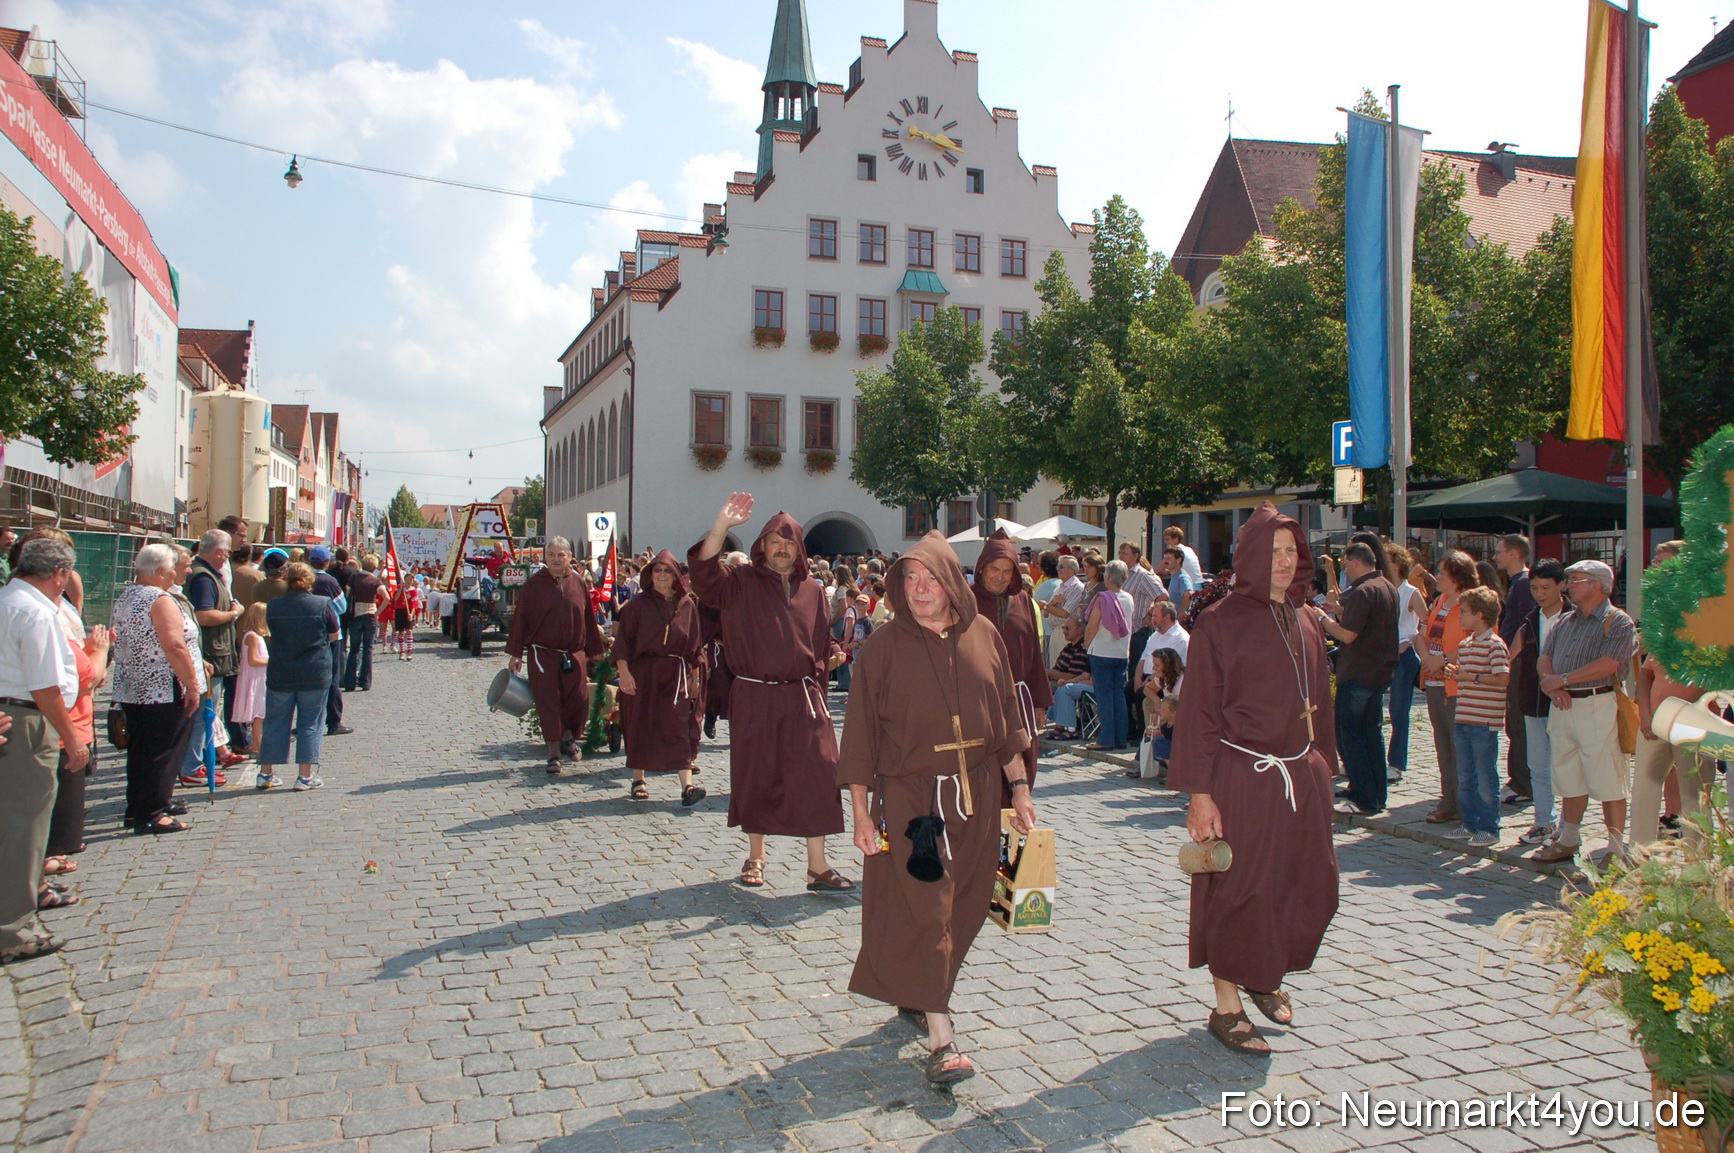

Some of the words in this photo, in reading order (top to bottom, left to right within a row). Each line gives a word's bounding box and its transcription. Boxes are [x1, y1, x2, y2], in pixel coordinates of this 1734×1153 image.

[0, 80, 57, 167] Sparkasse
[59, 144, 129, 257] Neumarkt-Parsberg
[402, 533, 435, 546] Kinder
[414, 545, 437, 556] Turn
[506, 568, 524, 577] BSC
